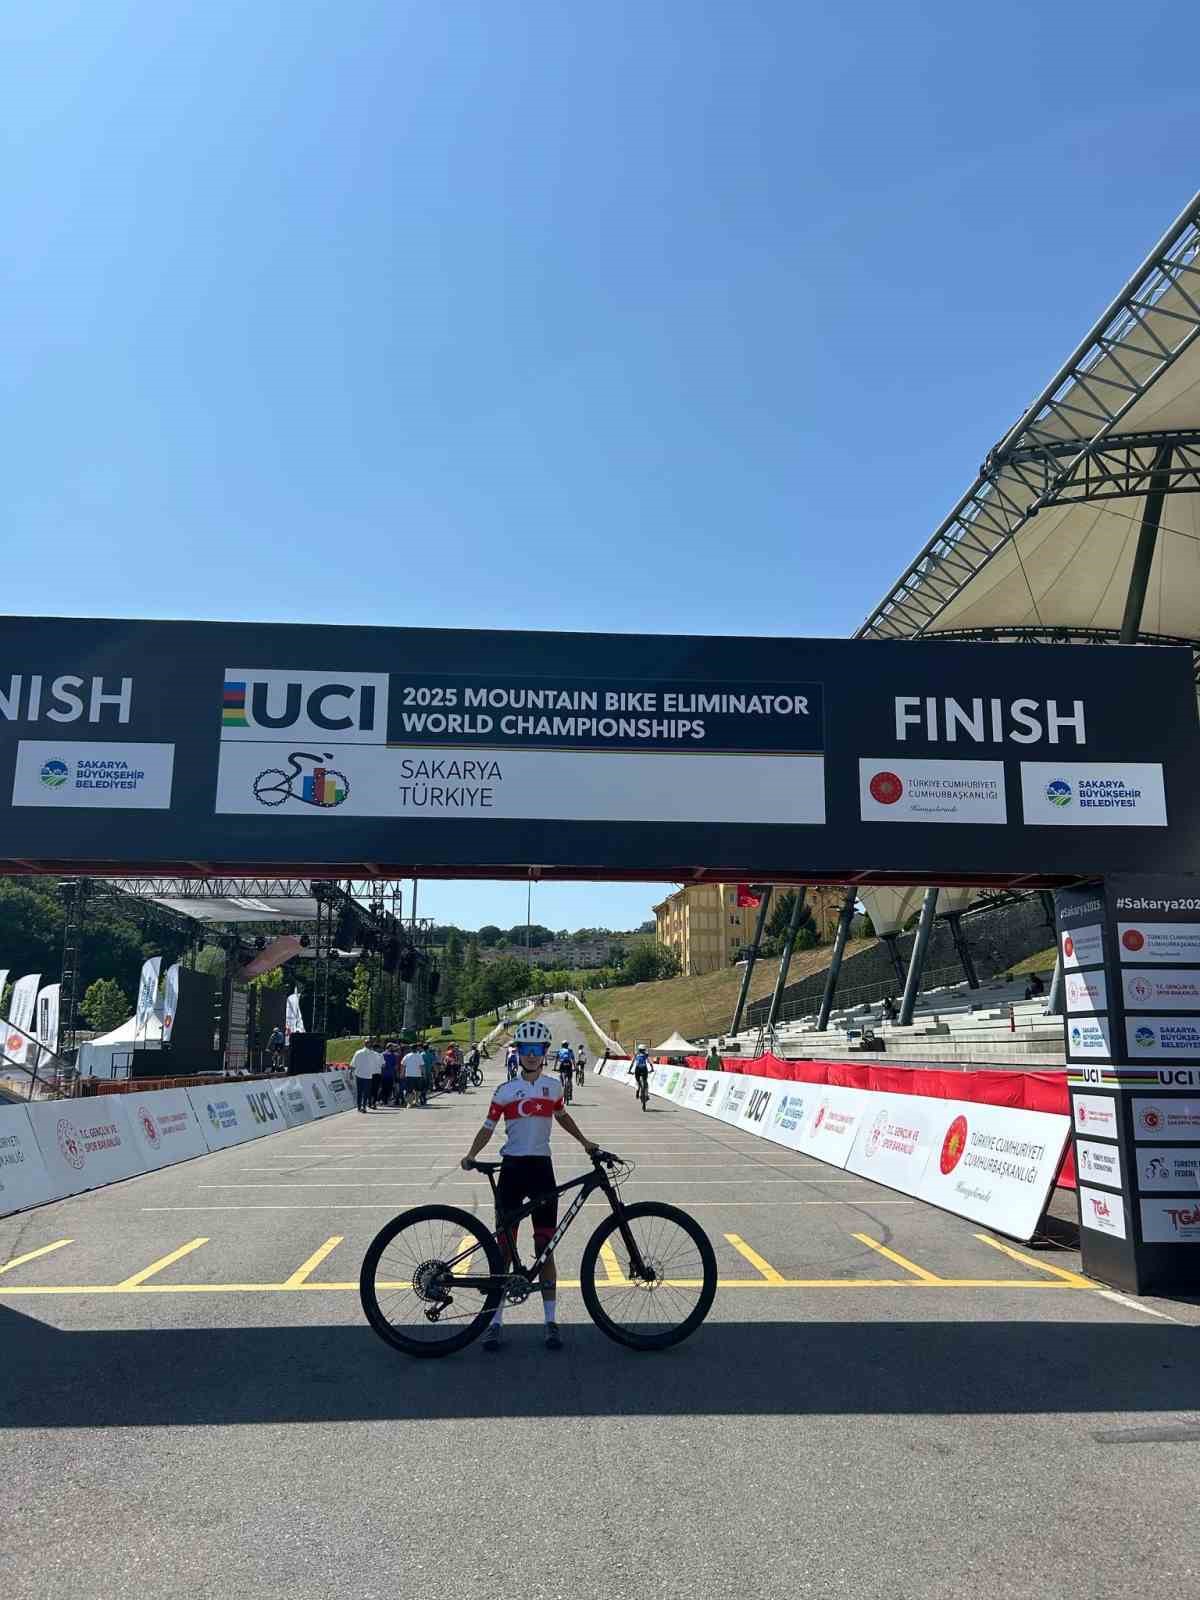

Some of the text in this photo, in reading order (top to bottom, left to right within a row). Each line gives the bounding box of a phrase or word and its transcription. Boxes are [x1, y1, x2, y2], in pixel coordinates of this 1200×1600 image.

[250, 680, 376, 732] UCI
[402, 687, 810, 717] 2025 MOUNTAIN BIKE ELIMINATOR
[401, 712, 706, 740] WORLD CHAMPIONSHIPS
[894, 696, 1087, 745] FINISH
[76, 760, 128, 770] SAKARYA
[400, 759, 503, 781] SAKARYA
[76, 769, 145, 780] BÜYÜKŞEHİR
[75, 780, 137, 790] BELEDİYESİ
[1078, 780, 1125, 789] SAKARYA
[1080, 798, 1137, 808] BELEDİYESİ
[1083, 1067, 1100, 1083] UCI
[1158, 1070, 1194, 1085] UCI
